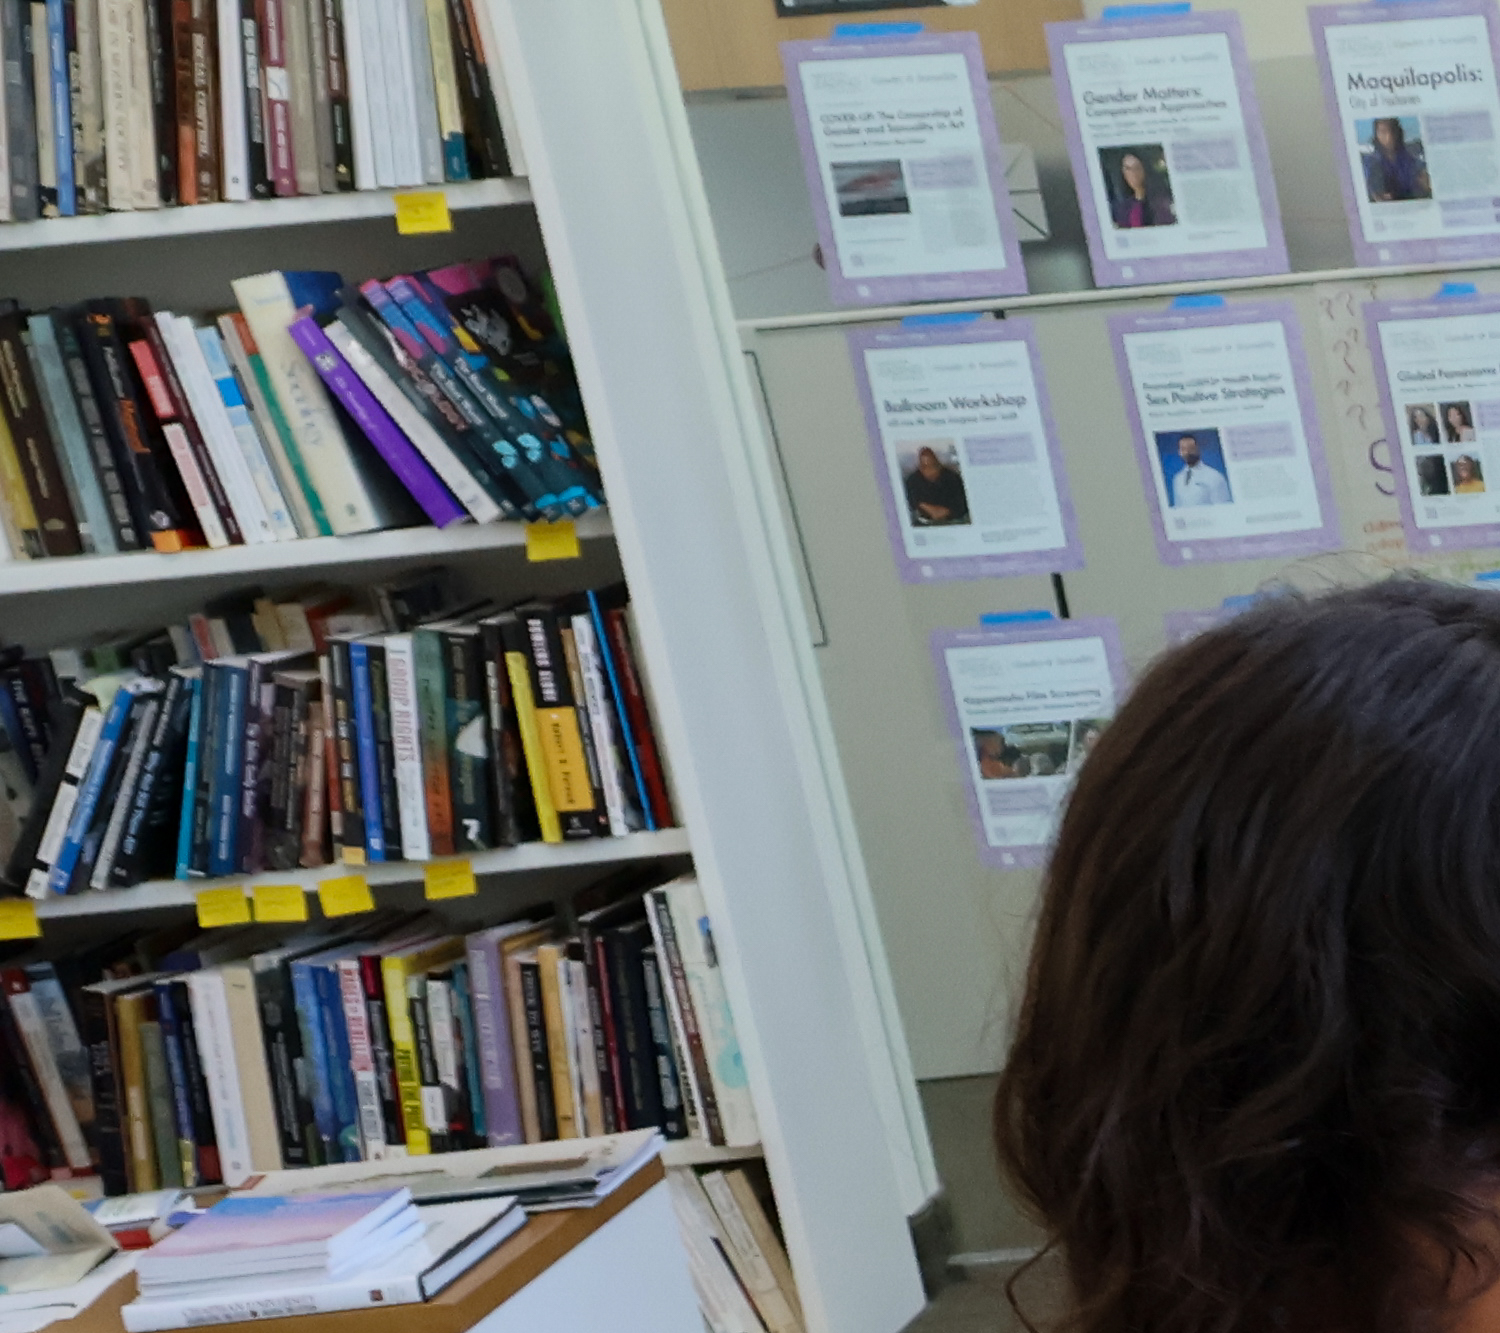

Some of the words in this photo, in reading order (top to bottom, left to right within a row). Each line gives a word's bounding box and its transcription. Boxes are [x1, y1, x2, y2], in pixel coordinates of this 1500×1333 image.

[1348, 63, 1483, 93] Maquilapolis:
[1083, 88, 1138, 105] Gender
[1397, 369, 1436, 382] Global
[884, 397, 947, 412] Ballroom
[949, 393, 1027, 410] Workshop
[389, 657, 410, 706] GROUP
[394, 709, 415, 762] RIGHTS
